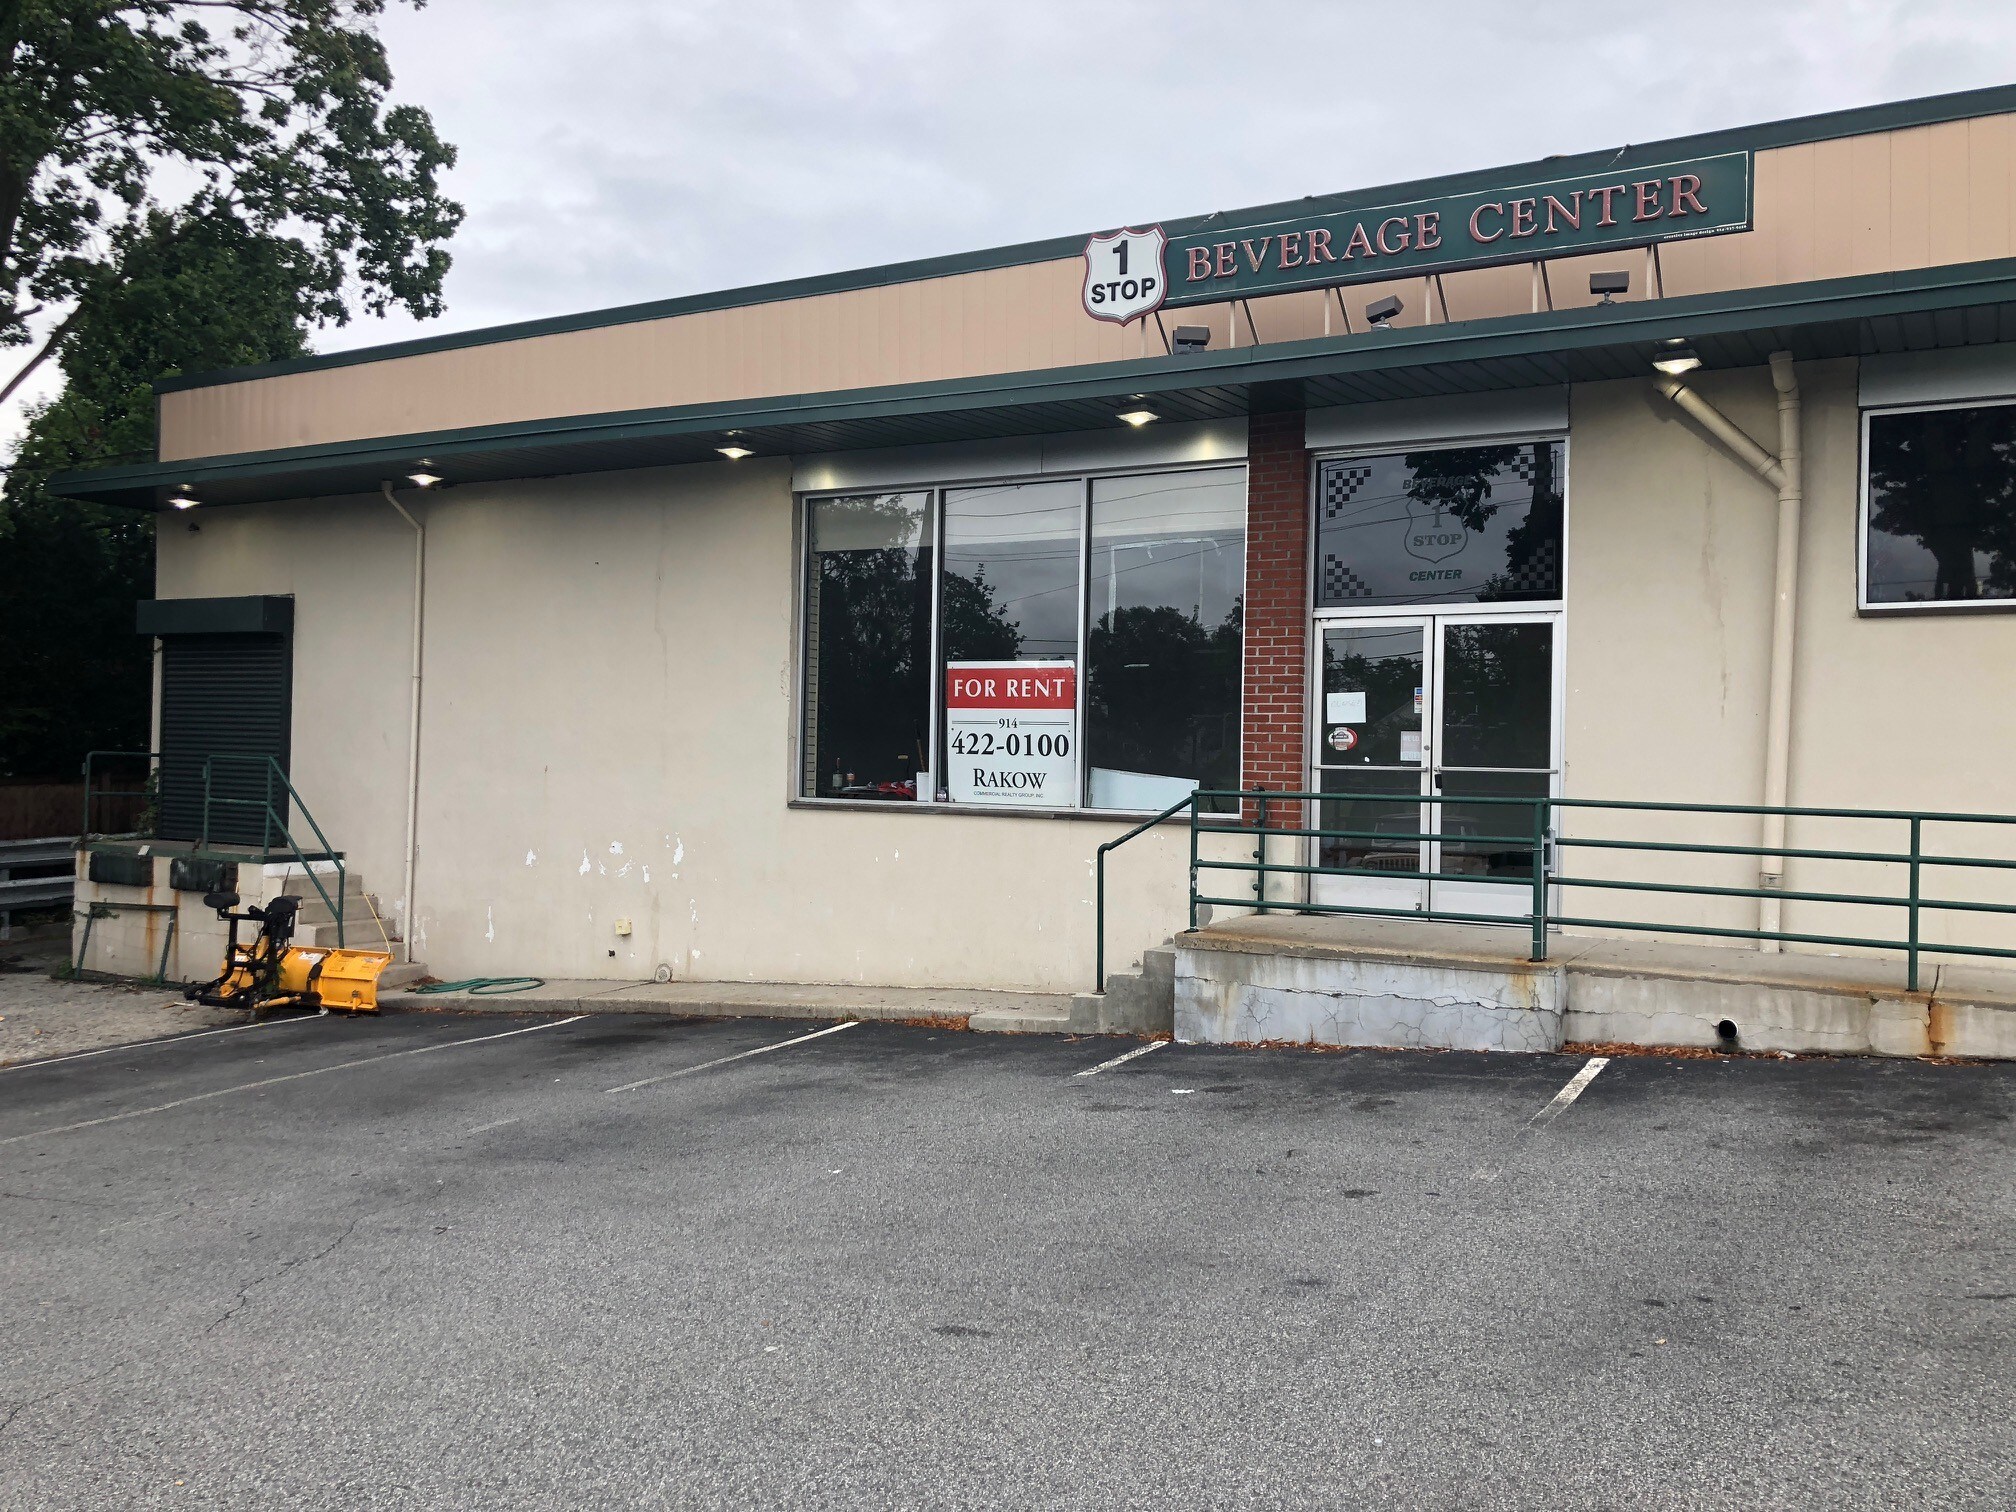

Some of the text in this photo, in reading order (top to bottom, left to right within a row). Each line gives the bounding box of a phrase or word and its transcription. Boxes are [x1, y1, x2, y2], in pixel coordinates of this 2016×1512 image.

[1185, 173, 1709, 283] BEVERAGE CENTER
[1112, 239, 1129, 276] 1
[1091, 277, 1156, 304] STOP
[1403, 475, 1473, 490] BEVERAGE
[1431, 504, 1442, 528] 1
[1413, 533, 1463, 547] STOP
[1409, 569, 1463, 582] CENTER
[954, 678, 1066, 698] FOR RENT
[998, 717, 1018, 729] 914
[951, 730, 1070, 757] 422-0100
[973, 768, 1048, 789] RAKOW
